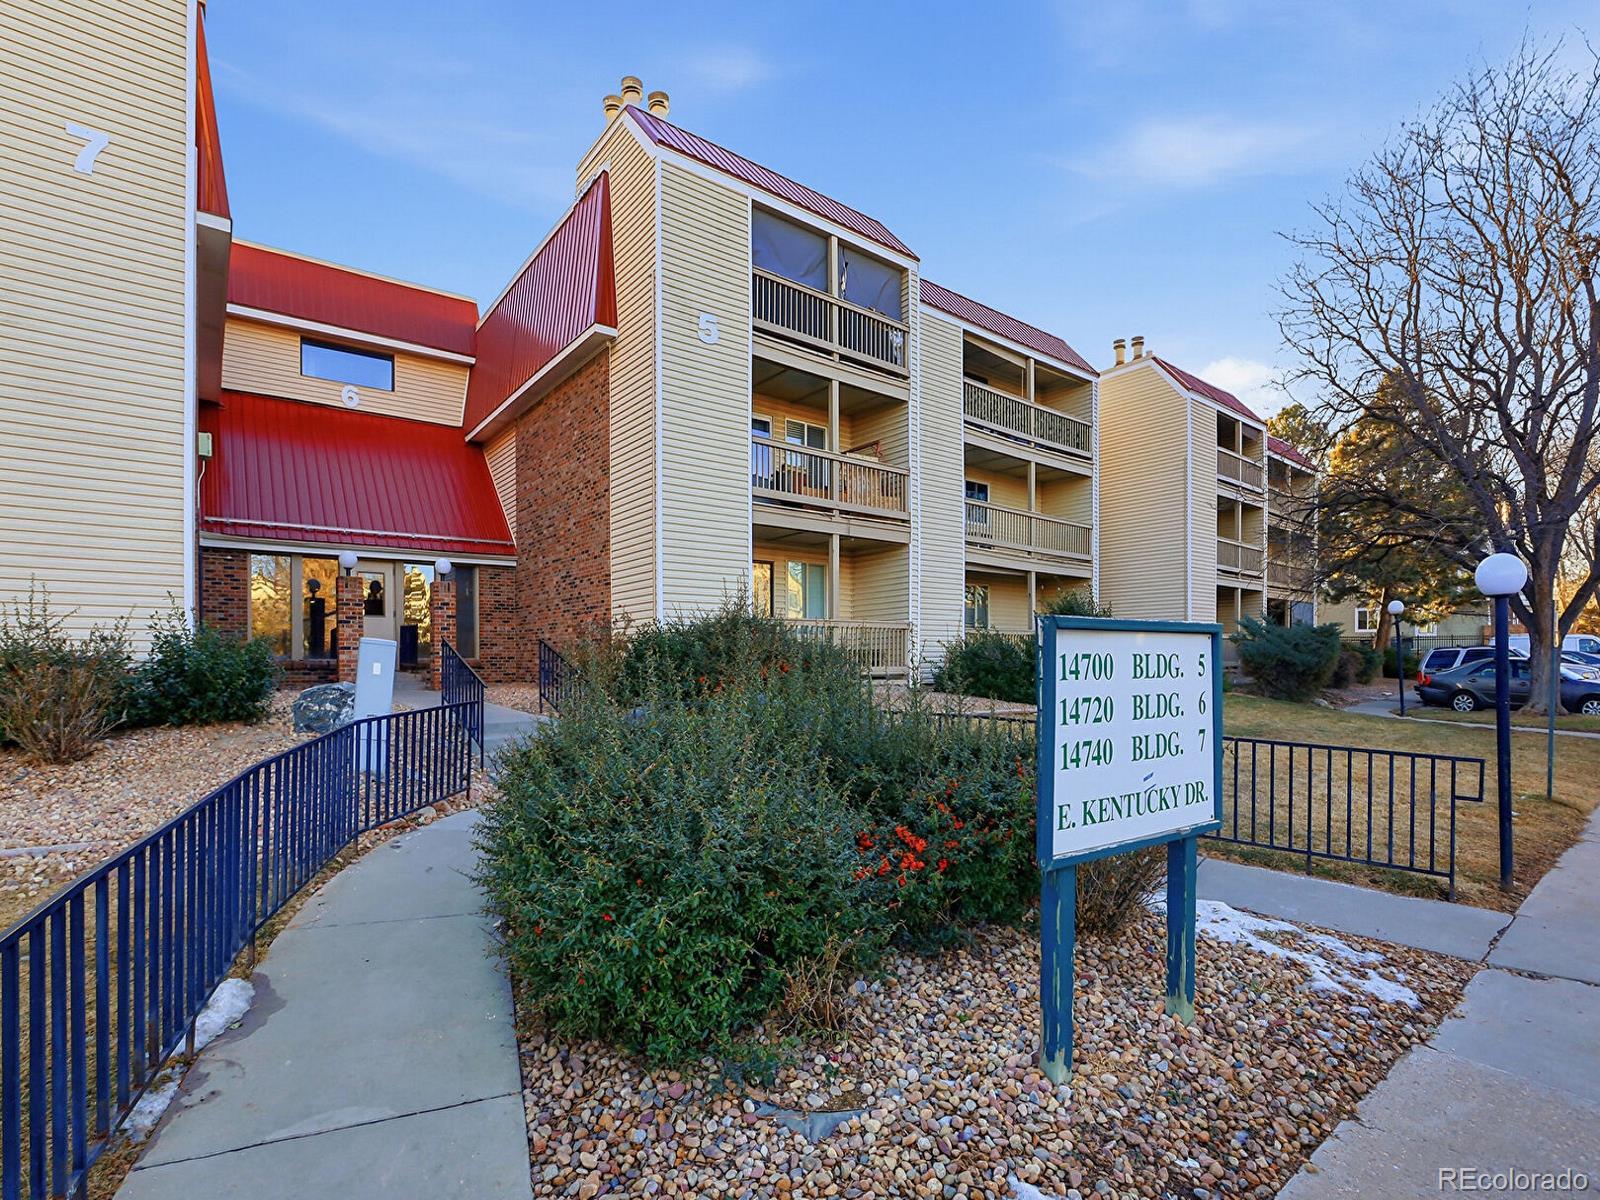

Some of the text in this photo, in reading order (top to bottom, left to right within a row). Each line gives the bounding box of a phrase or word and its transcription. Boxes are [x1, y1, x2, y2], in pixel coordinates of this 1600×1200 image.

[64, 122, 110, 176] 7
[697, 311, 720, 344] 5
[341, 384, 360, 408] 6
[1059, 653, 1206, 681] 14700 BLDG. 5
[1059, 691, 1206, 726] 14720 BLDG. 6
[1060, 729, 1206, 770] 14740 BLDG. 7
[1057, 780, 1209, 831] E. KENTUCKY DR.
